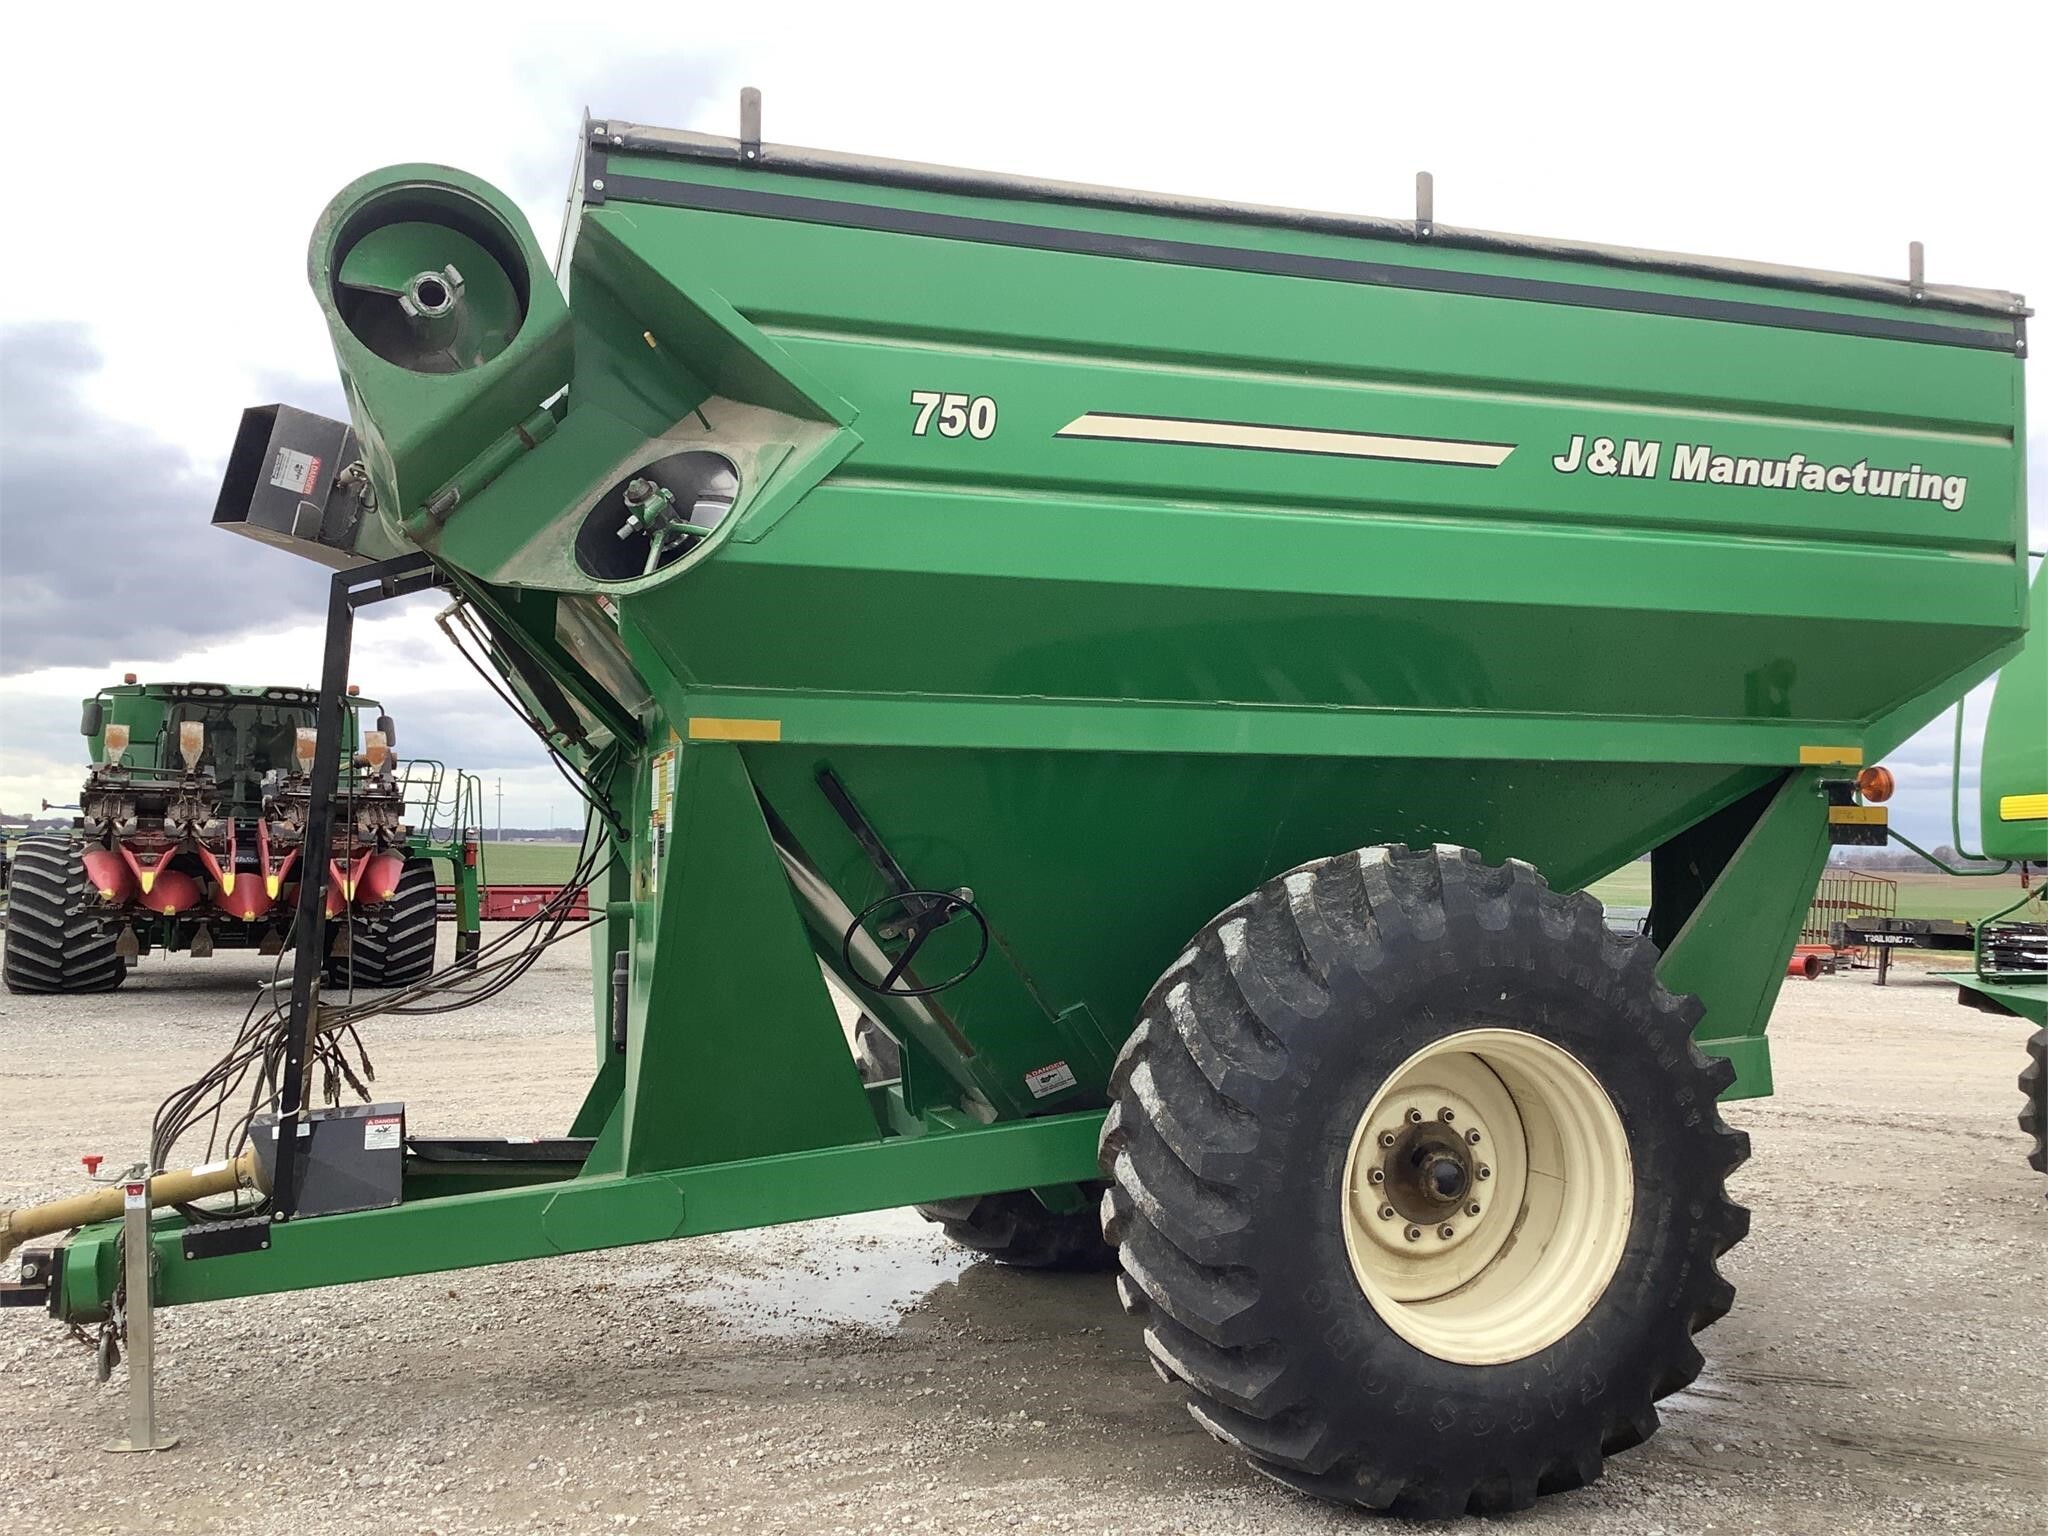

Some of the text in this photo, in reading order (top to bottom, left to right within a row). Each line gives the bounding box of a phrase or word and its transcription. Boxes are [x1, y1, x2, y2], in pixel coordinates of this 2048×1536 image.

[910, 390, 998, 440] 750
[304, 464, 319, 494] DANGER
[1553, 434, 1968, 511] J&M Manufacturing
[1031, 1060, 1066, 1077] DANGER
